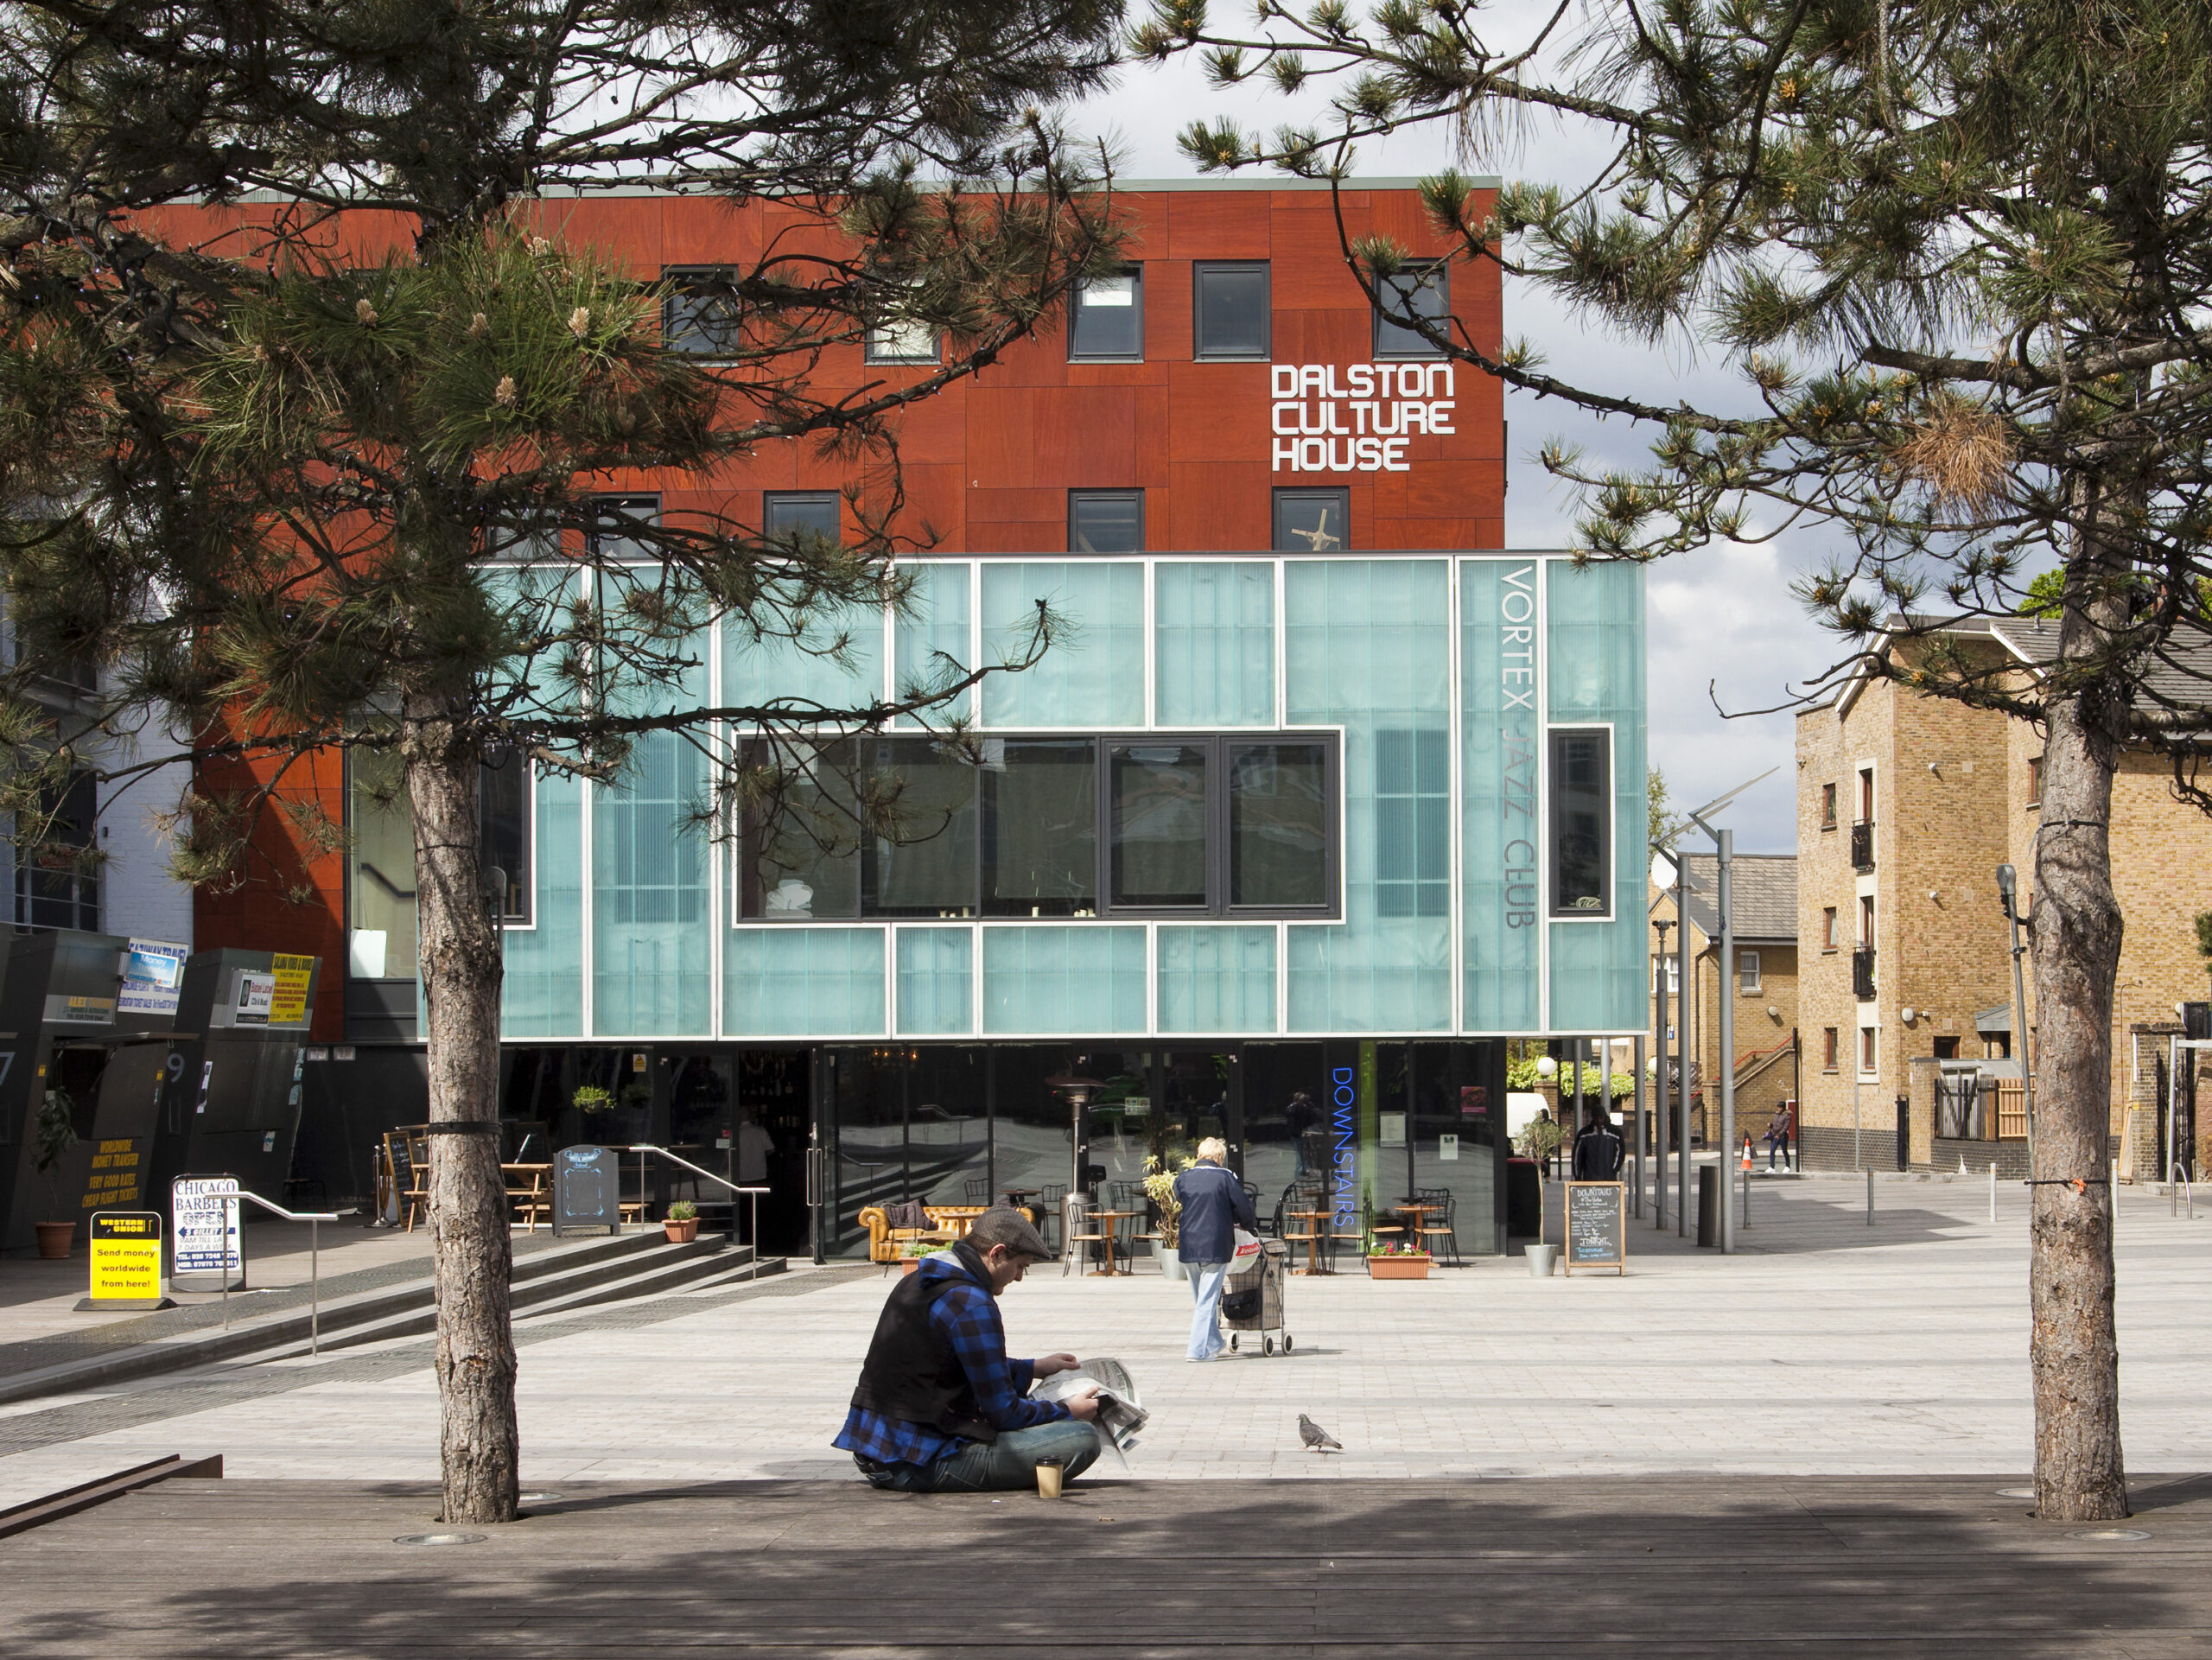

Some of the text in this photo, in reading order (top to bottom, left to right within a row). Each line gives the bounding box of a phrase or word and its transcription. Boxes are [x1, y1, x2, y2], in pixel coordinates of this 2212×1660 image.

[1271, 363, 1454, 398] DALSTON
[1272, 401, 1455, 435] CULTURE
[1272, 437, 1410, 472] HOUSE
[1500, 564, 1536, 930] VORTEX JAZZ CLUB
[140, 954, 167, 966] Money
[167, 1053, 185, 1083] 9
[99, 1139, 132, 1154] WORLDWIDE
[1332, 1067, 1355, 1227] DOWNSTAIRS
[92, 1153, 139, 1168] MONEY TRANSFER
[89, 1173, 137, 1189] VERY GOOD RATES
[175, 1180, 236, 1195] CHICAGO
[82, 1186, 138, 1208] CHEAP FLIGHT TICKETS
